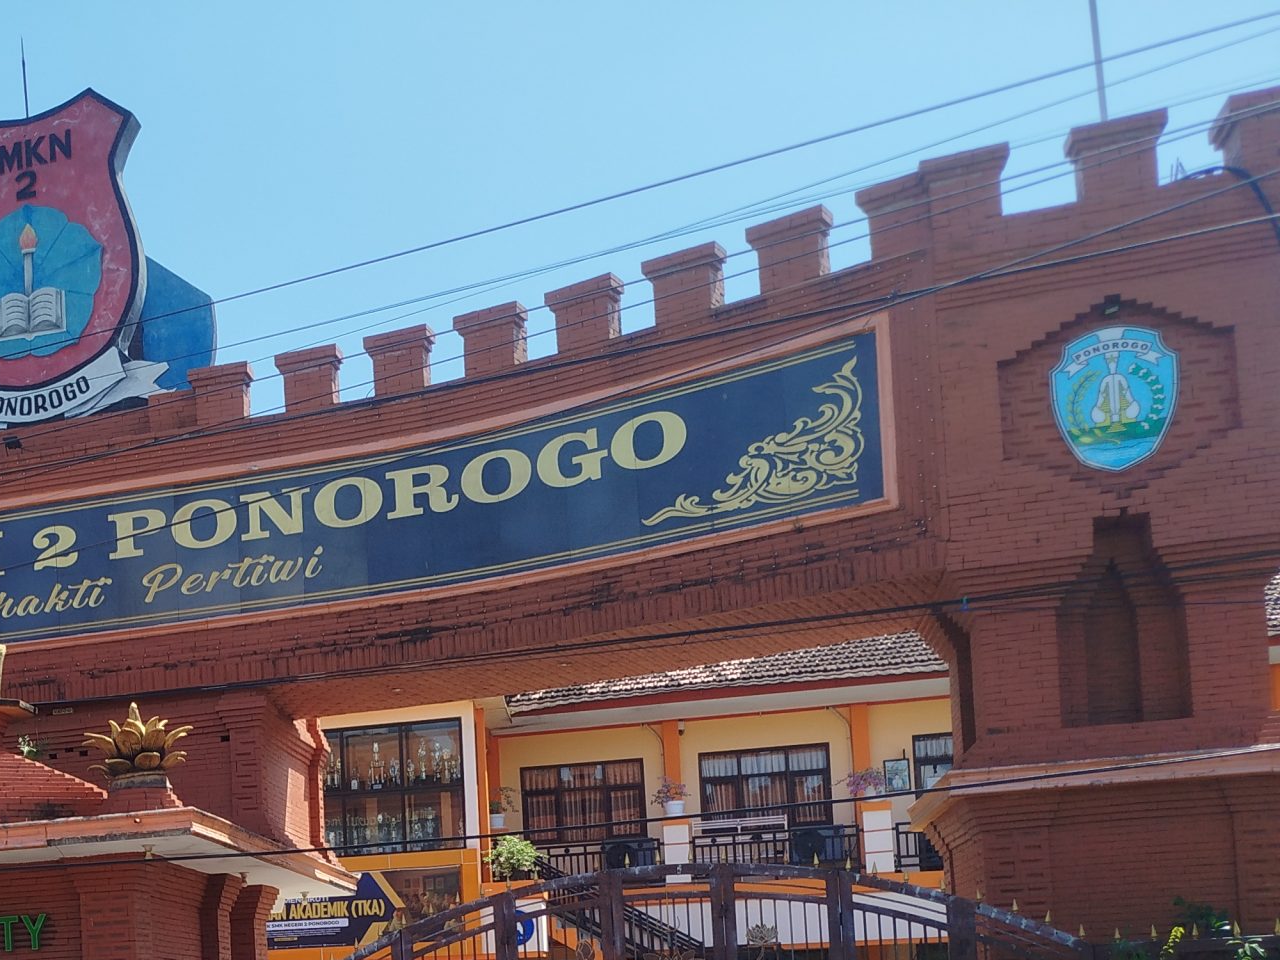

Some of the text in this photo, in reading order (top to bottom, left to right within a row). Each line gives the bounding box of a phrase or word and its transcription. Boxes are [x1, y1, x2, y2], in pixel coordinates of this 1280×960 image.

[15, 171, 37, 201] 2
[1074, 341, 1150, 361] PONOROGO
[32, 525, 80, 571] 2
[107, 411, 688, 560] PONOROGO
[142, 545, 324, 604] Pertiwi
[289, 900, 350, 921] AKADEMIK
[351, 898, 386, 919] (TKA)
